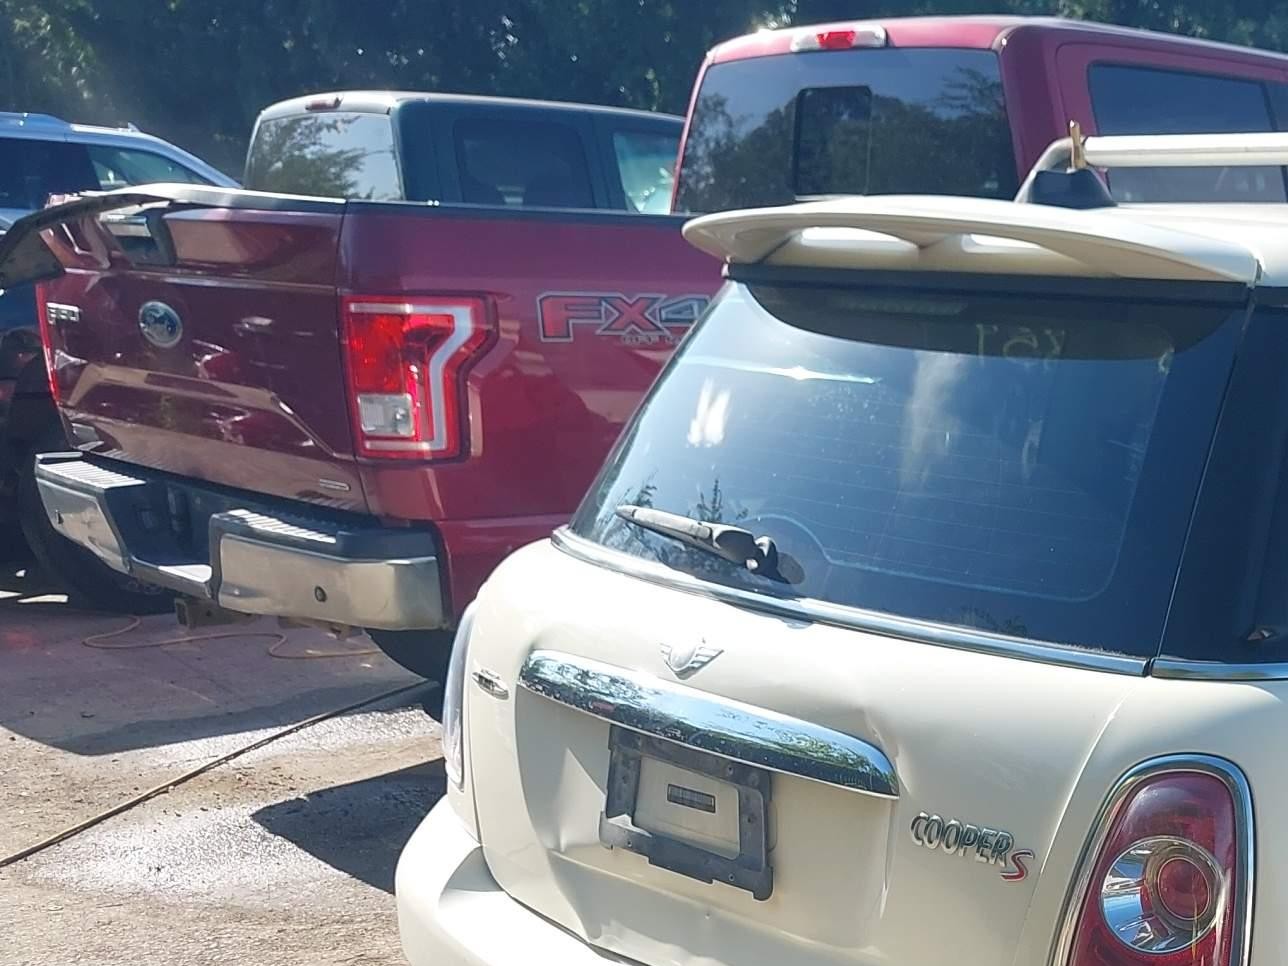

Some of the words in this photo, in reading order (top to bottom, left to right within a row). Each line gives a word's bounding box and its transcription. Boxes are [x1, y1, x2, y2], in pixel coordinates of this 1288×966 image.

[536, 291, 712, 342] FX4
[910, 811, 1014, 868] COOPER
[1000, 849, 1035, 881] S
